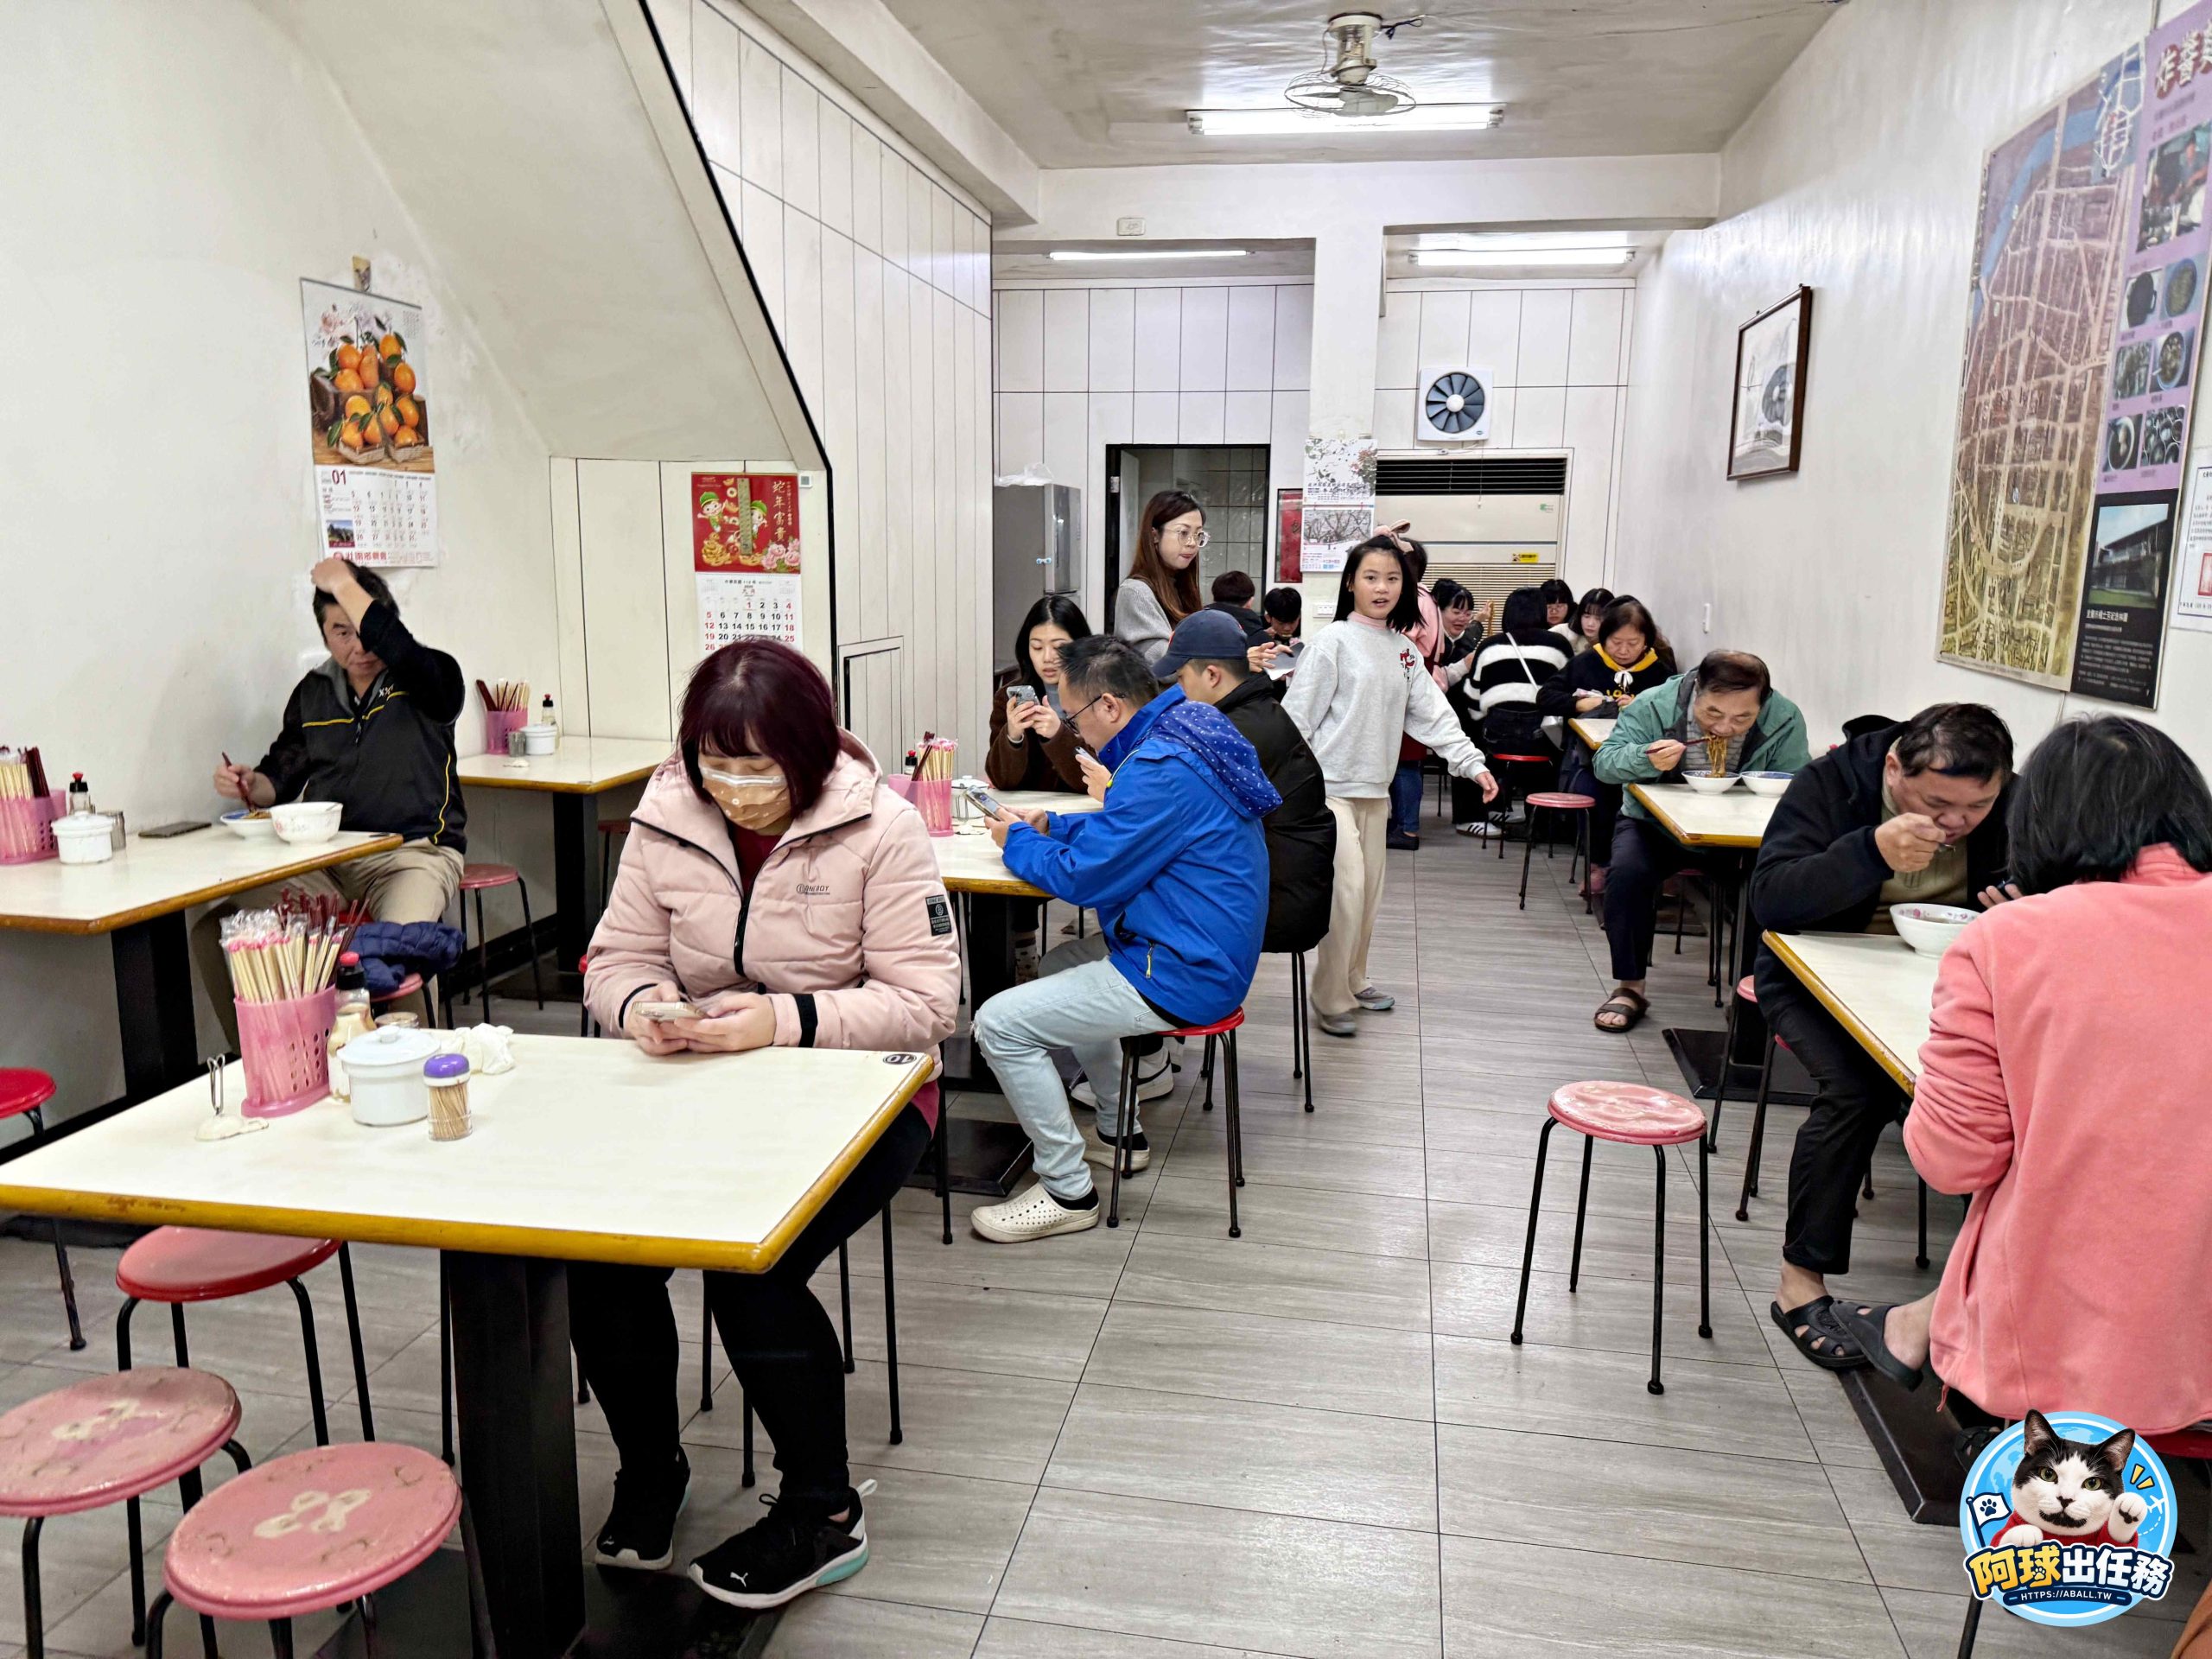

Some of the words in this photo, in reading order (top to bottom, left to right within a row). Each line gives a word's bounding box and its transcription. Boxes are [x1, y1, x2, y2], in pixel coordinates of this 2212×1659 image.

[332, 469, 346, 485] 01
[772, 480, 786, 542] 蛇年富貴
